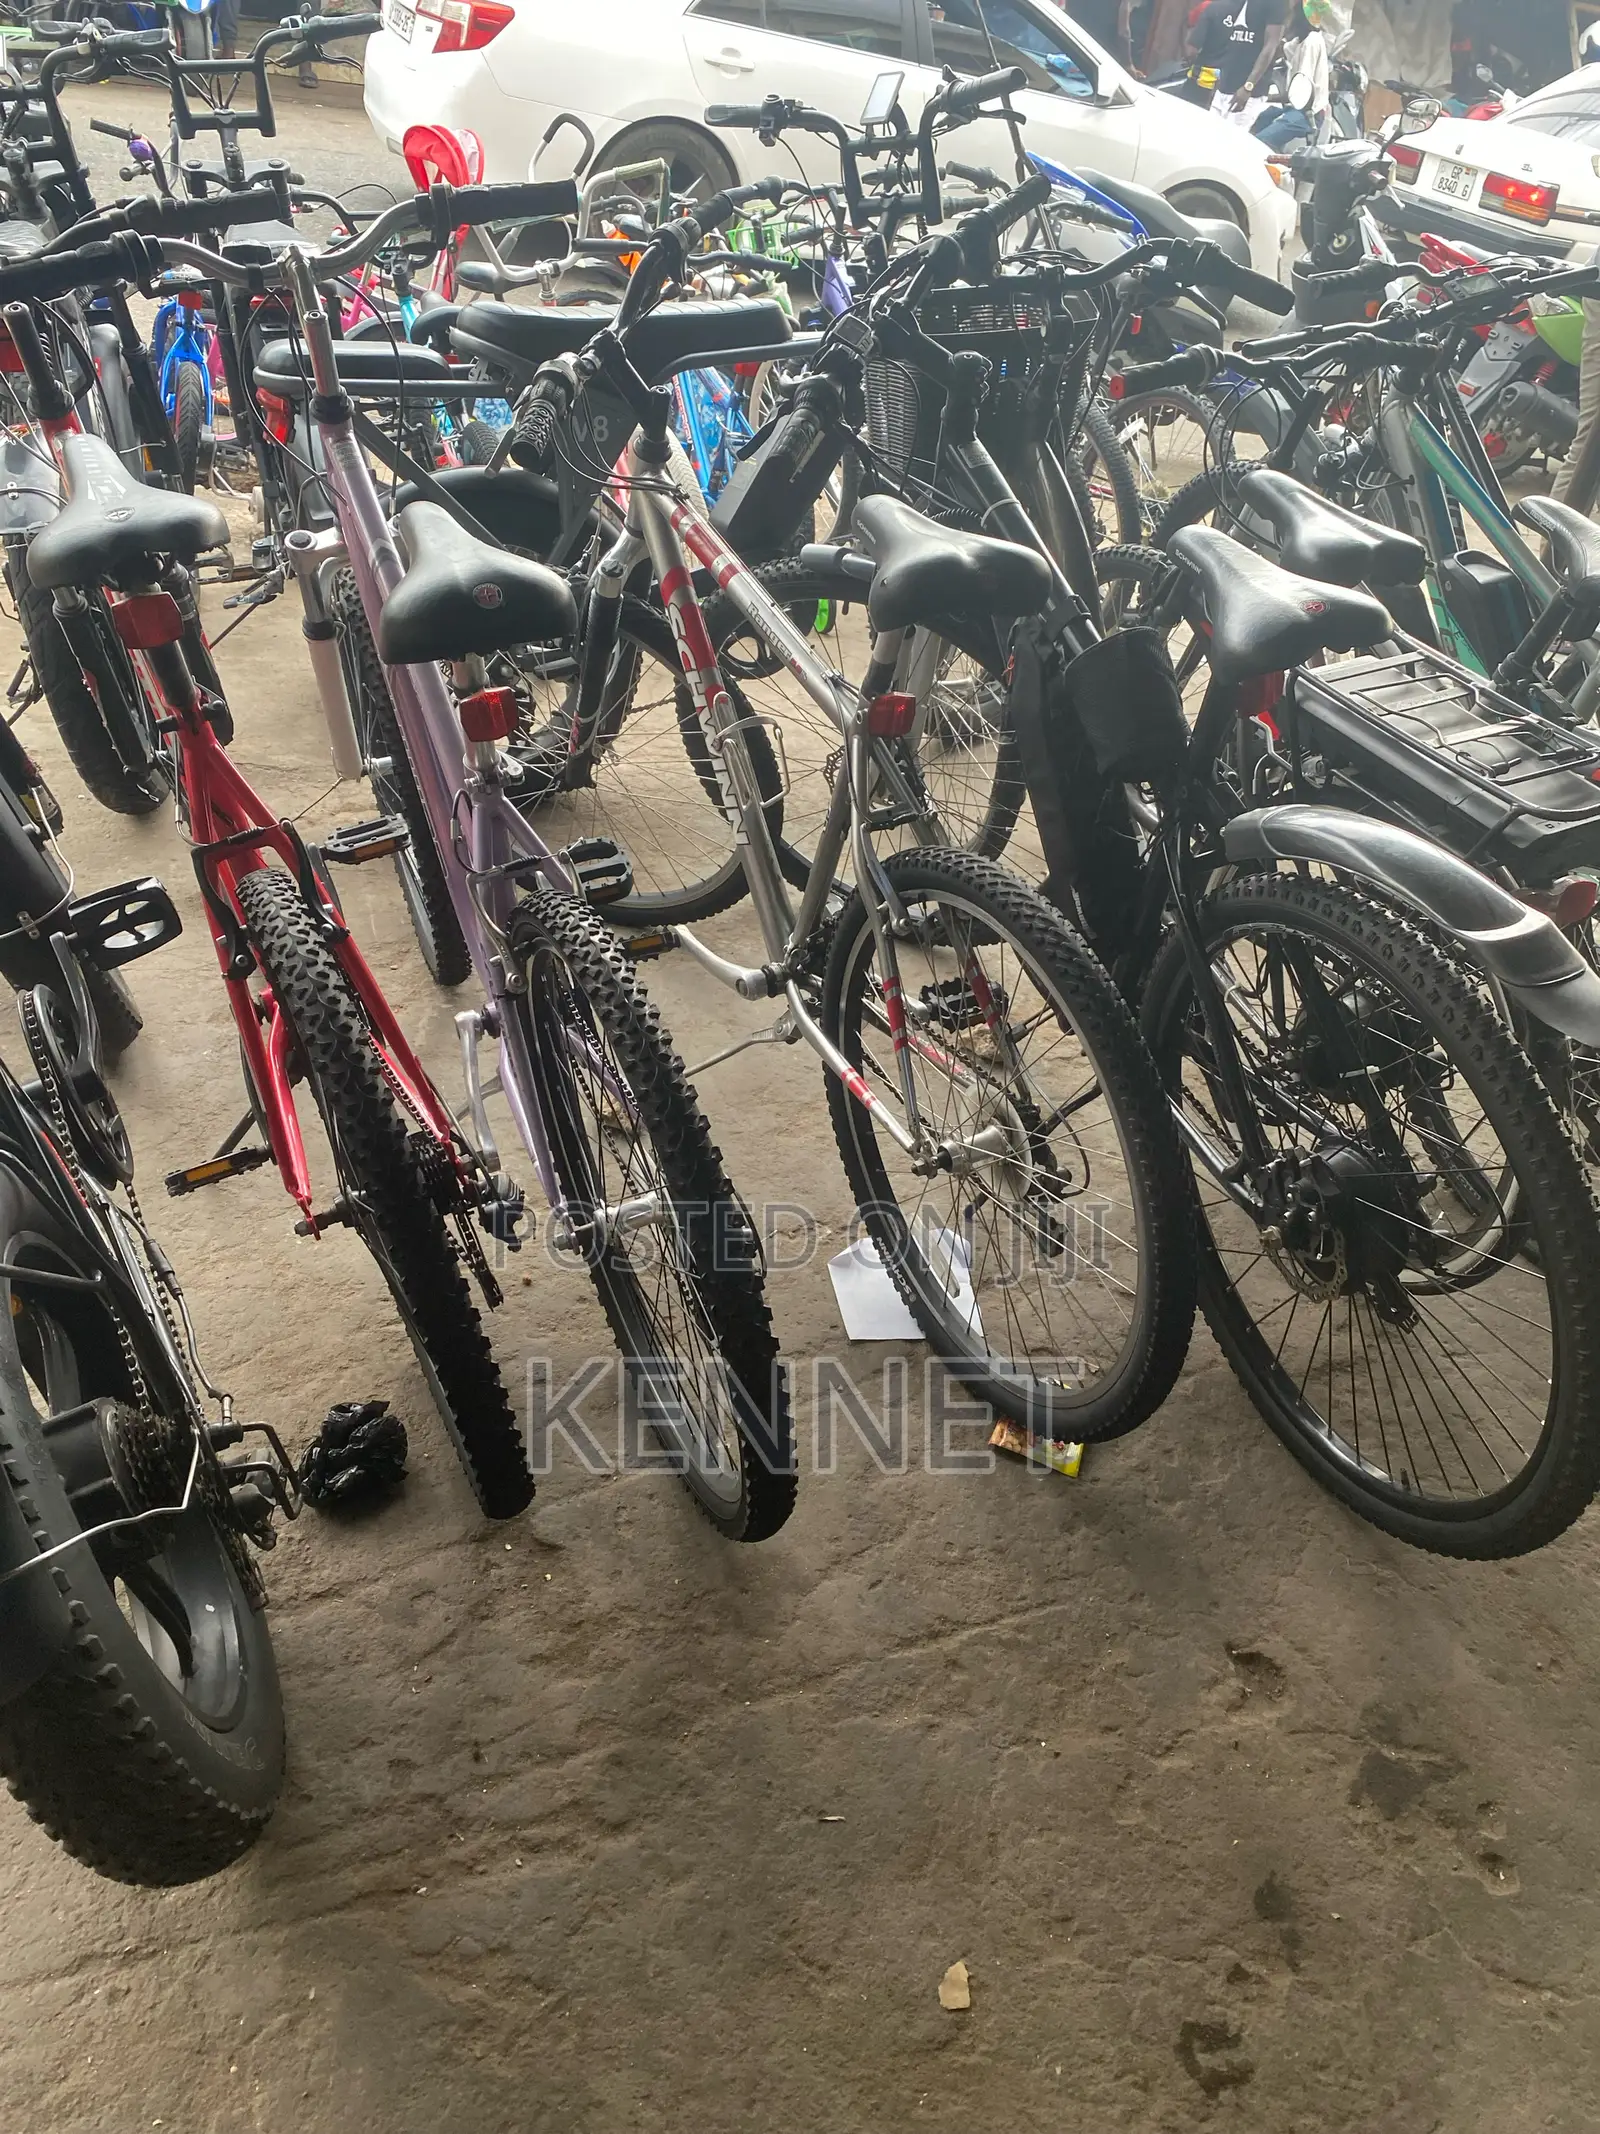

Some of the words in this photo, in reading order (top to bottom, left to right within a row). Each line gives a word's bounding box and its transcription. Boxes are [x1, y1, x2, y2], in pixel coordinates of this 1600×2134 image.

[1437, 176, 1458, 194] 8340
[1461, 184, 1470, 197] G
[1174, 548, 1202, 575] SCHWINN
[746, 601, 793, 661] Ranger
[876, 1236, 912, 1294] SCHWINN
